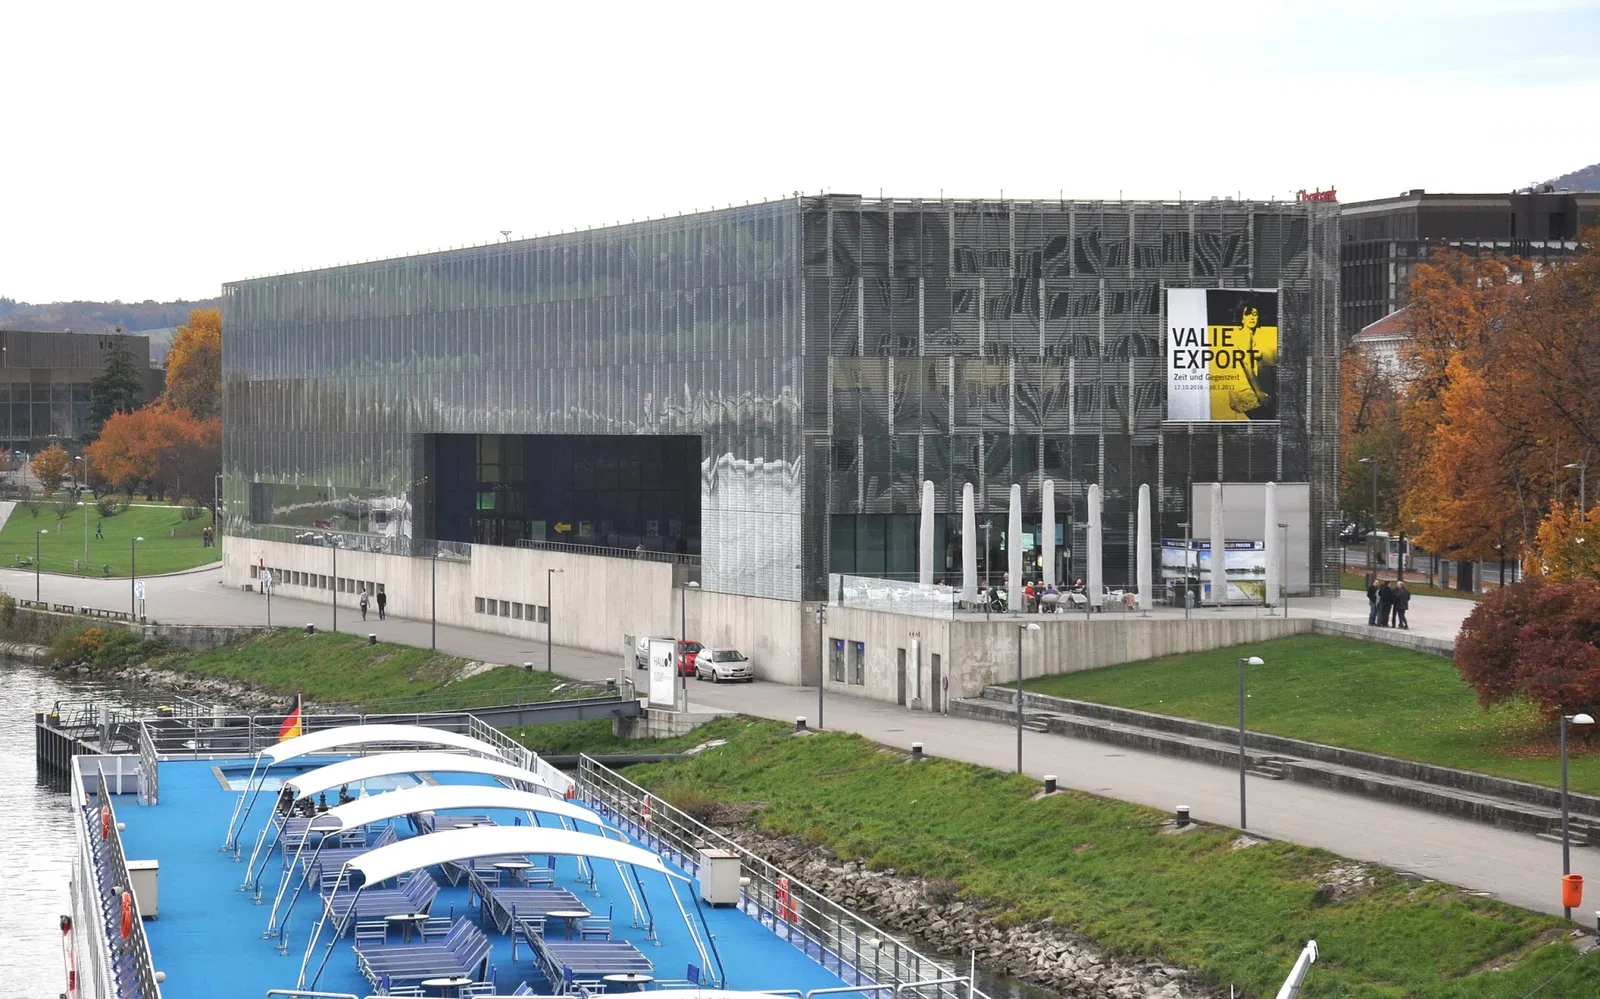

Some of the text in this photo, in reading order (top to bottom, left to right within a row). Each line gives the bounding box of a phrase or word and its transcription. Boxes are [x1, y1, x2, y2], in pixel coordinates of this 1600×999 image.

[1172, 328, 1234, 347] VALIE
[1173, 350, 1259, 369] EXPORT
[1205, 374, 1240, 382] Gegenzeit
